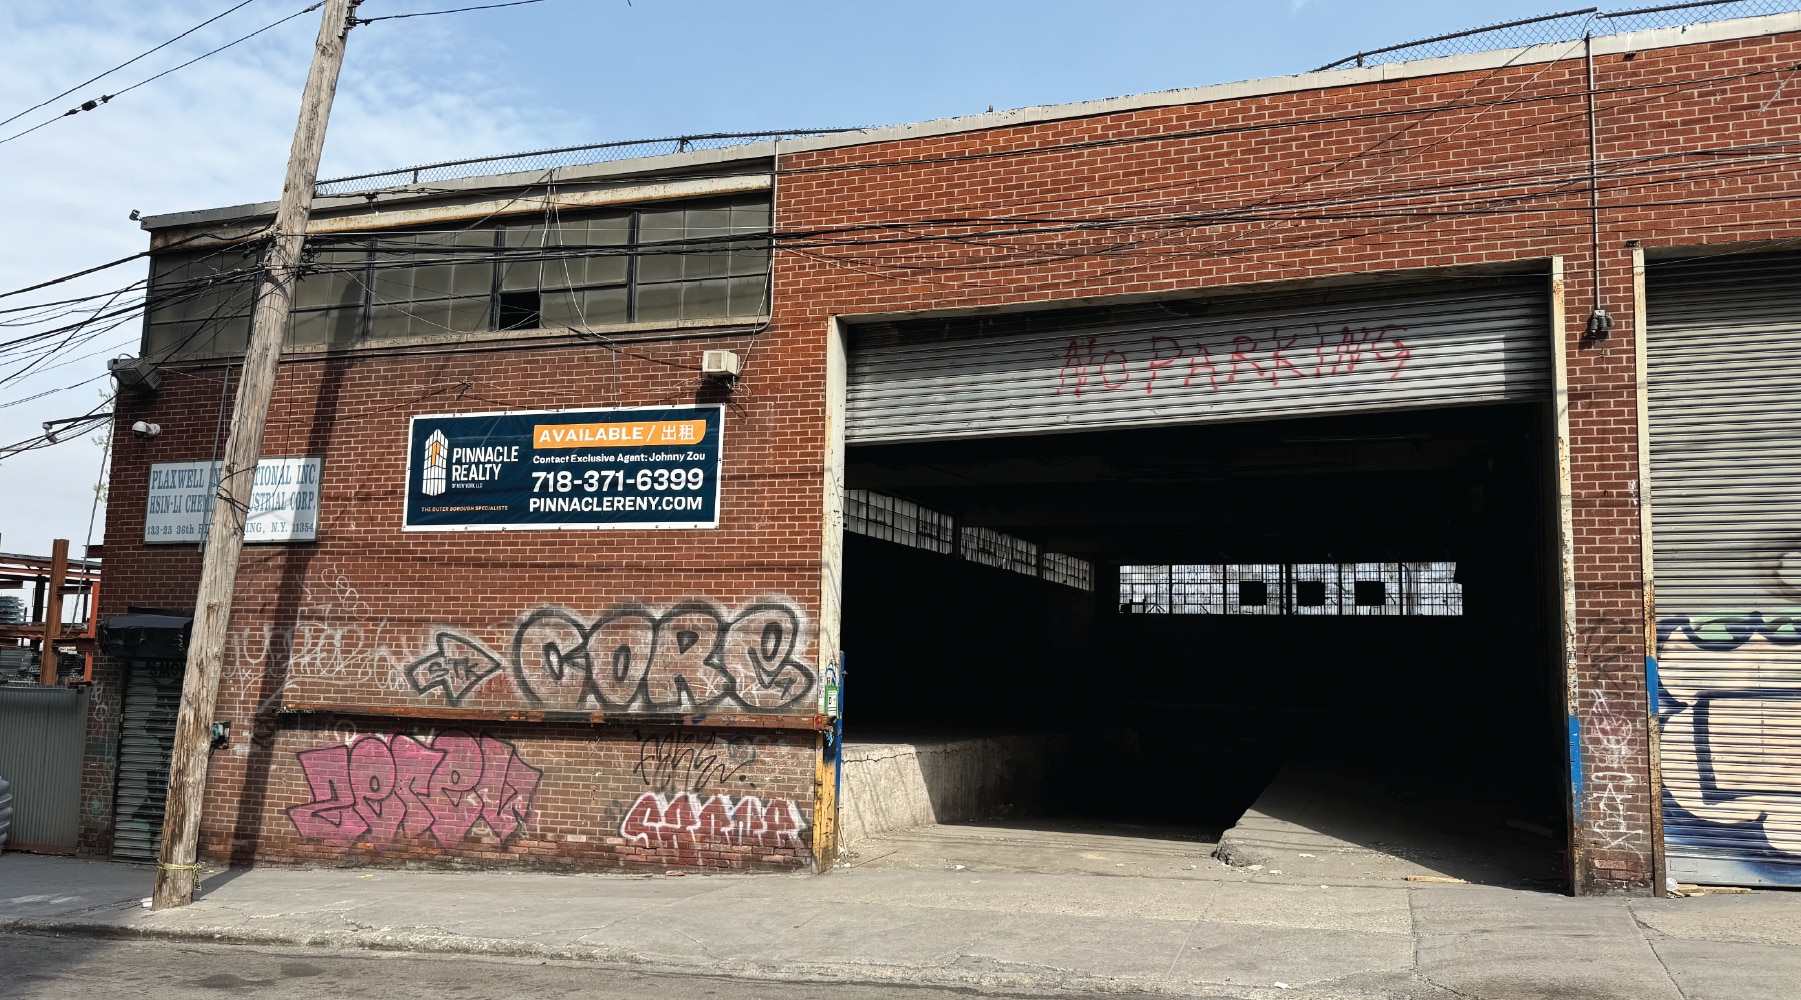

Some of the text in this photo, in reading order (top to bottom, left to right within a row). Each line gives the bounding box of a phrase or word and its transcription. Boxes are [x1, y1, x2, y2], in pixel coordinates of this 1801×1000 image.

[1056, 324, 1411, 398] NO PARKING
[539, 427, 644, 443] AVAILABLE
[660, 424, 695, 441] 出租
[452, 445, 519, 463] PINNACLE
[533, 451, 706, 464] Contact Exclusive Agent: Johnny Zou
[151, 468, 205, 490] PLAXWELL
[295, 463, 318, 485] INC.
[451, 463, 502, 481] REALTY
[531, 467, 704, 493] 718-371-6399
[289, 490, 316, 510] CORP.
[529, 496, 703, 513] PINNACLERENY.COM
[176, 524, 194, 535] 36th
[271, 521, 288, 532] N.Y.
[292, 522, 314, 532] 11354
